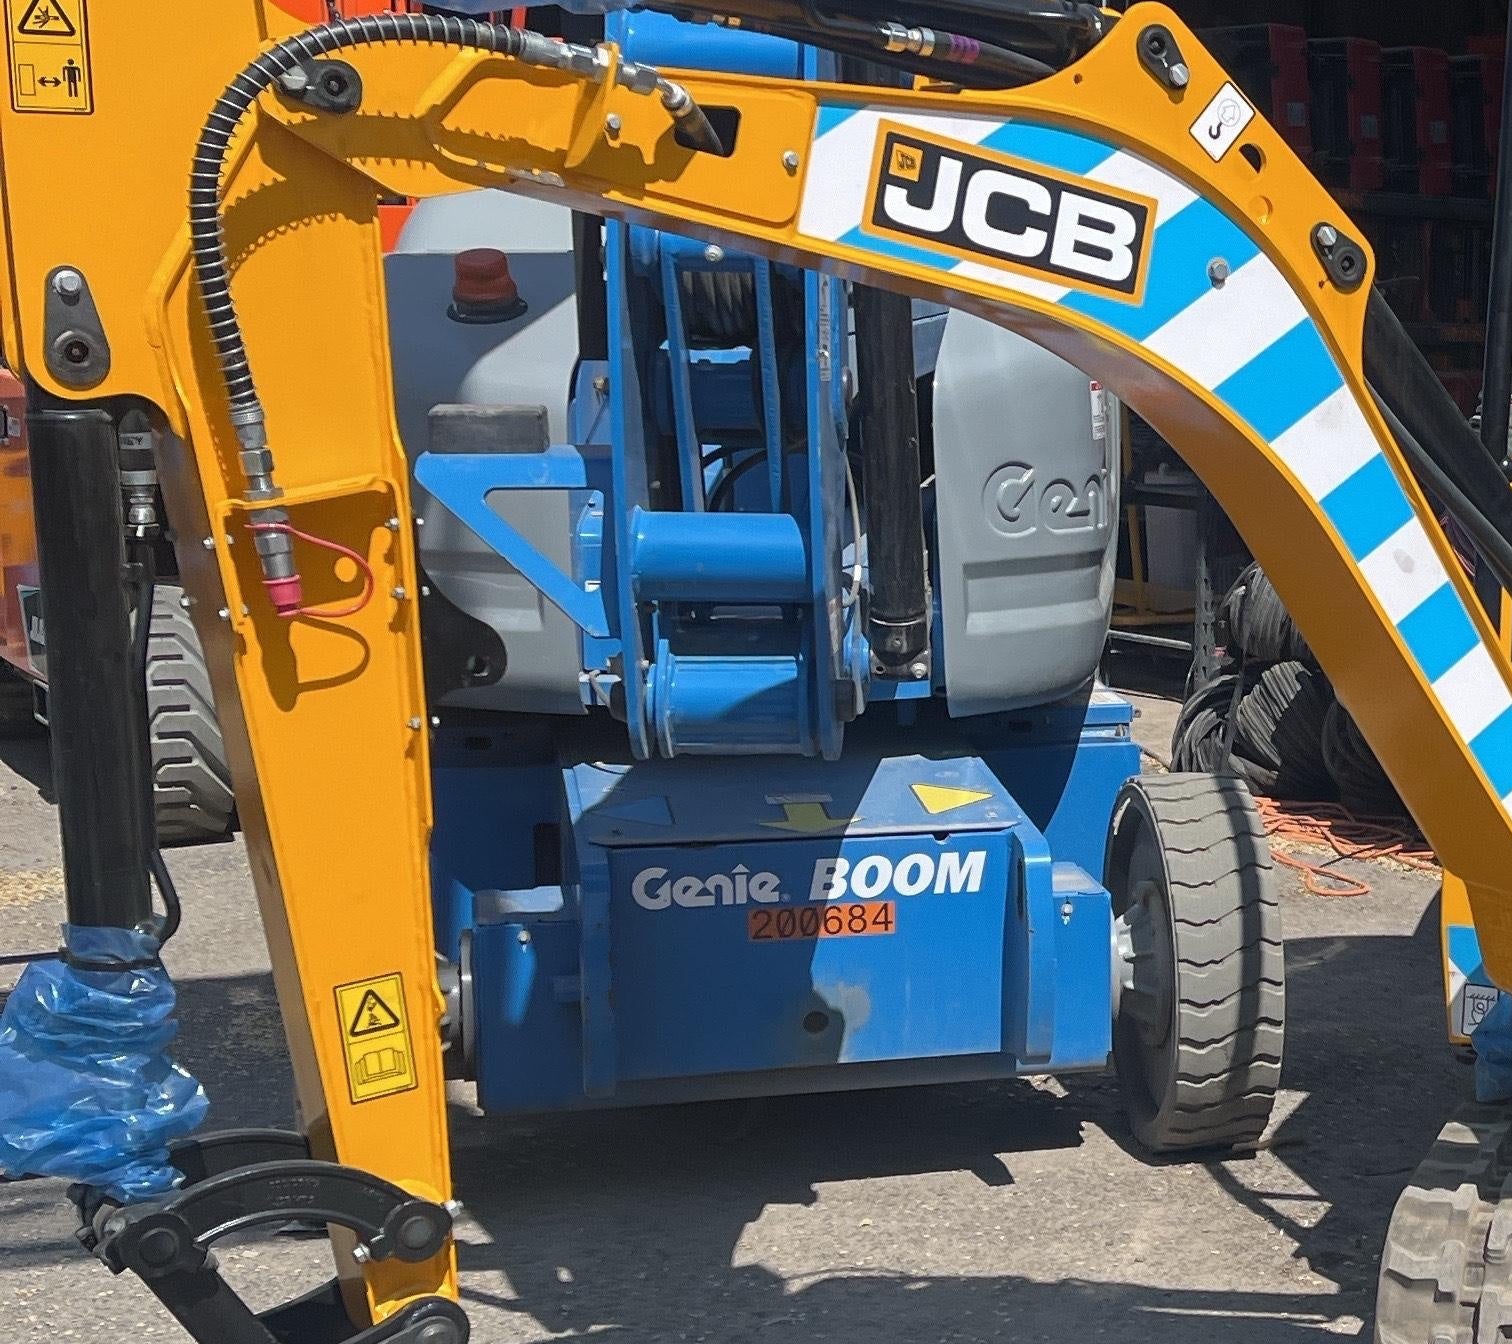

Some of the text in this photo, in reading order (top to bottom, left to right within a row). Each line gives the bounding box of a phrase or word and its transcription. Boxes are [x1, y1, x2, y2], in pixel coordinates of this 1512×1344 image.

[883, 155, 1138, 283] JCB
[631, 849, 988, 911] Genie BOOM
[750, 902, 894, 940] 200684
